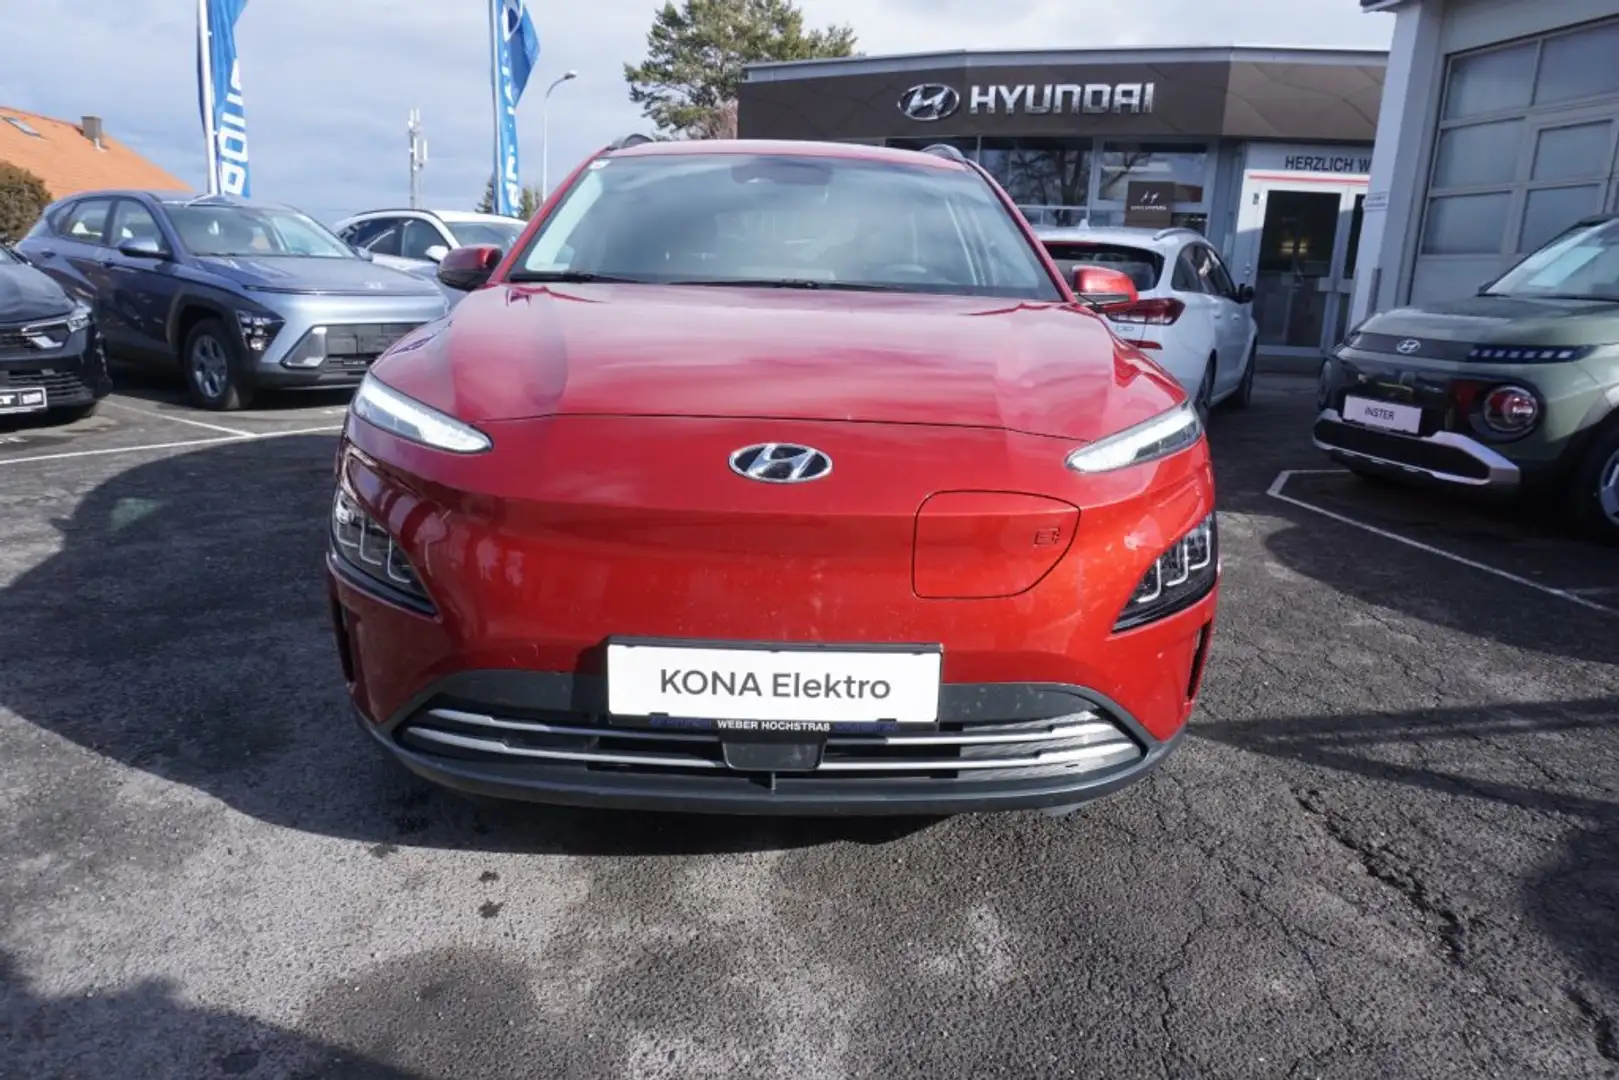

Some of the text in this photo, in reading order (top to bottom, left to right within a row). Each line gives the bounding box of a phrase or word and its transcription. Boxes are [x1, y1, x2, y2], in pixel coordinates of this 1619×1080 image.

[969, 82, 1155, 114] HYUNDAI
[1285, 155, 1354, 172] HERZLICH
[1364, 406, 1394, 420] INSTER
[660, 669, 891, 699] KONA Elektro
[717, 719, 759, 730] WEBER
